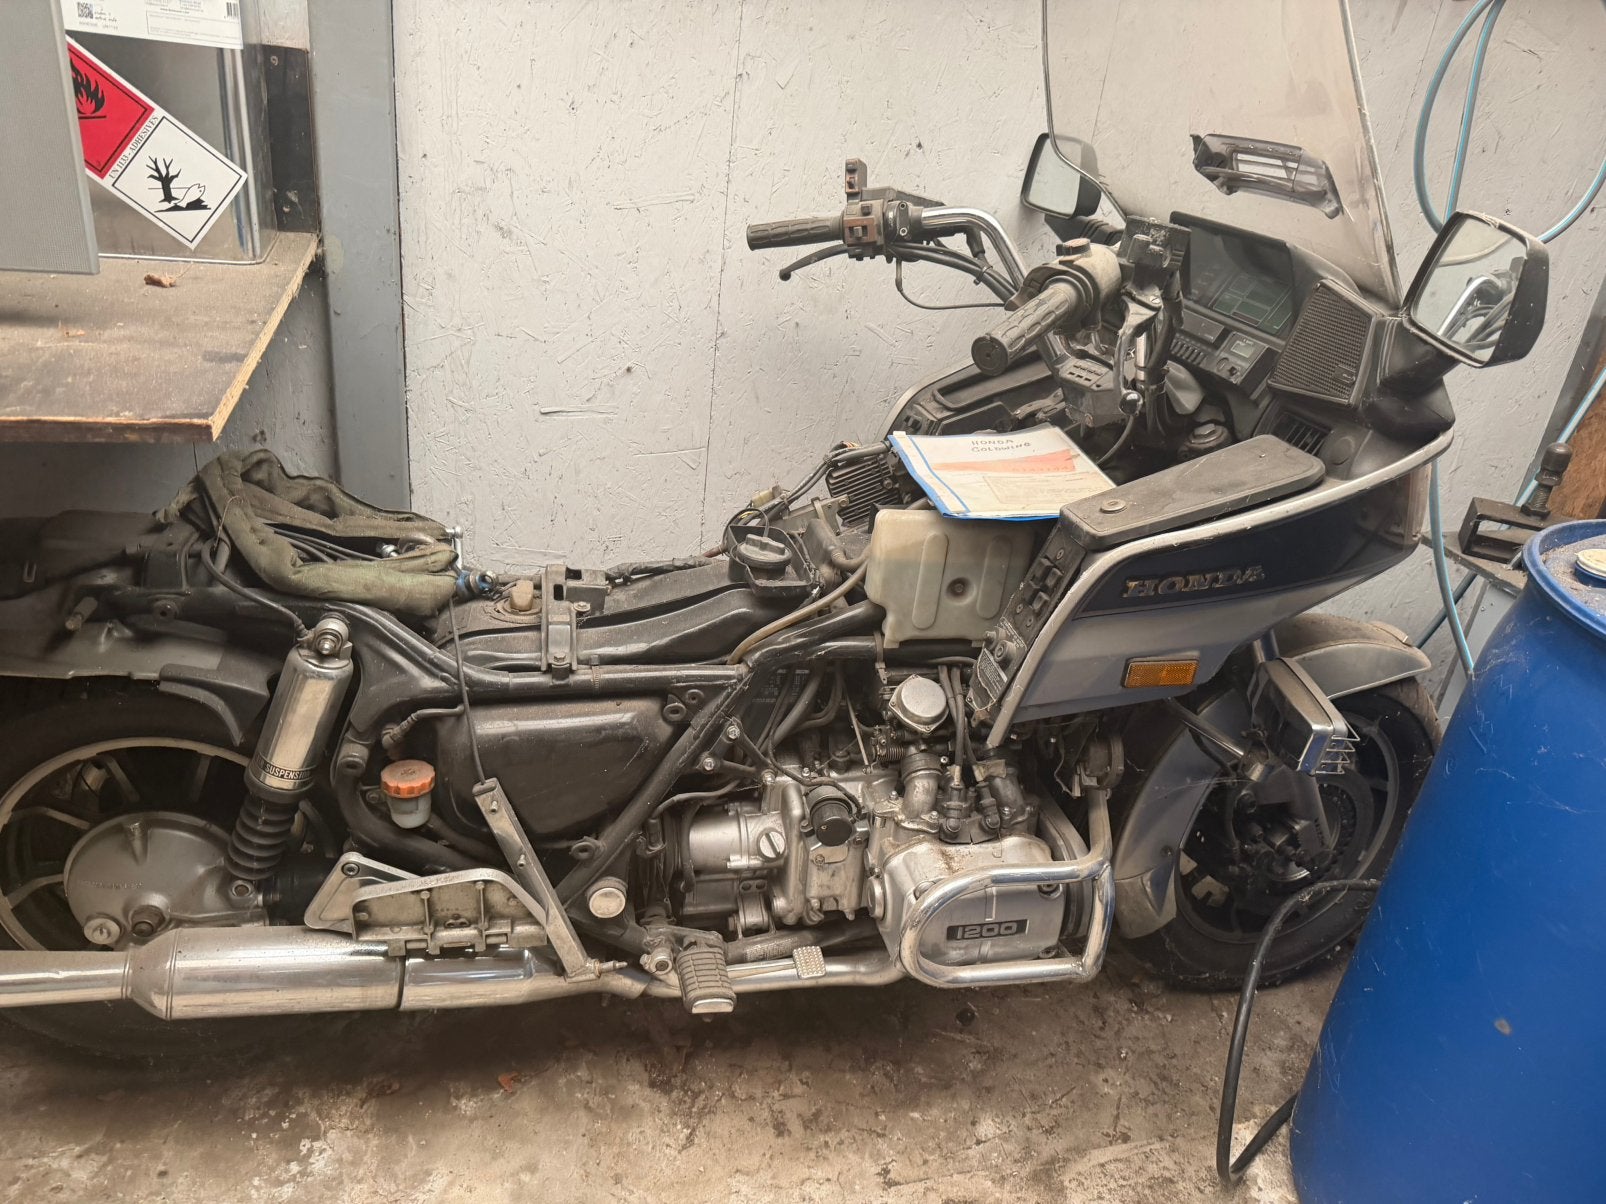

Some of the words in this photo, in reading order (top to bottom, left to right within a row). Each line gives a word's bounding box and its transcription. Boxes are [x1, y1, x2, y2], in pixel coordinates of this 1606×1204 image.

[108, 169, 119, 179] UN
[116, 154, 129, 169] 1133
[129, 115, 159, 154] ADHESIVES
[1122, 565, 1265, 598] HONDA
[957, 922, 1017, 939] 1200
